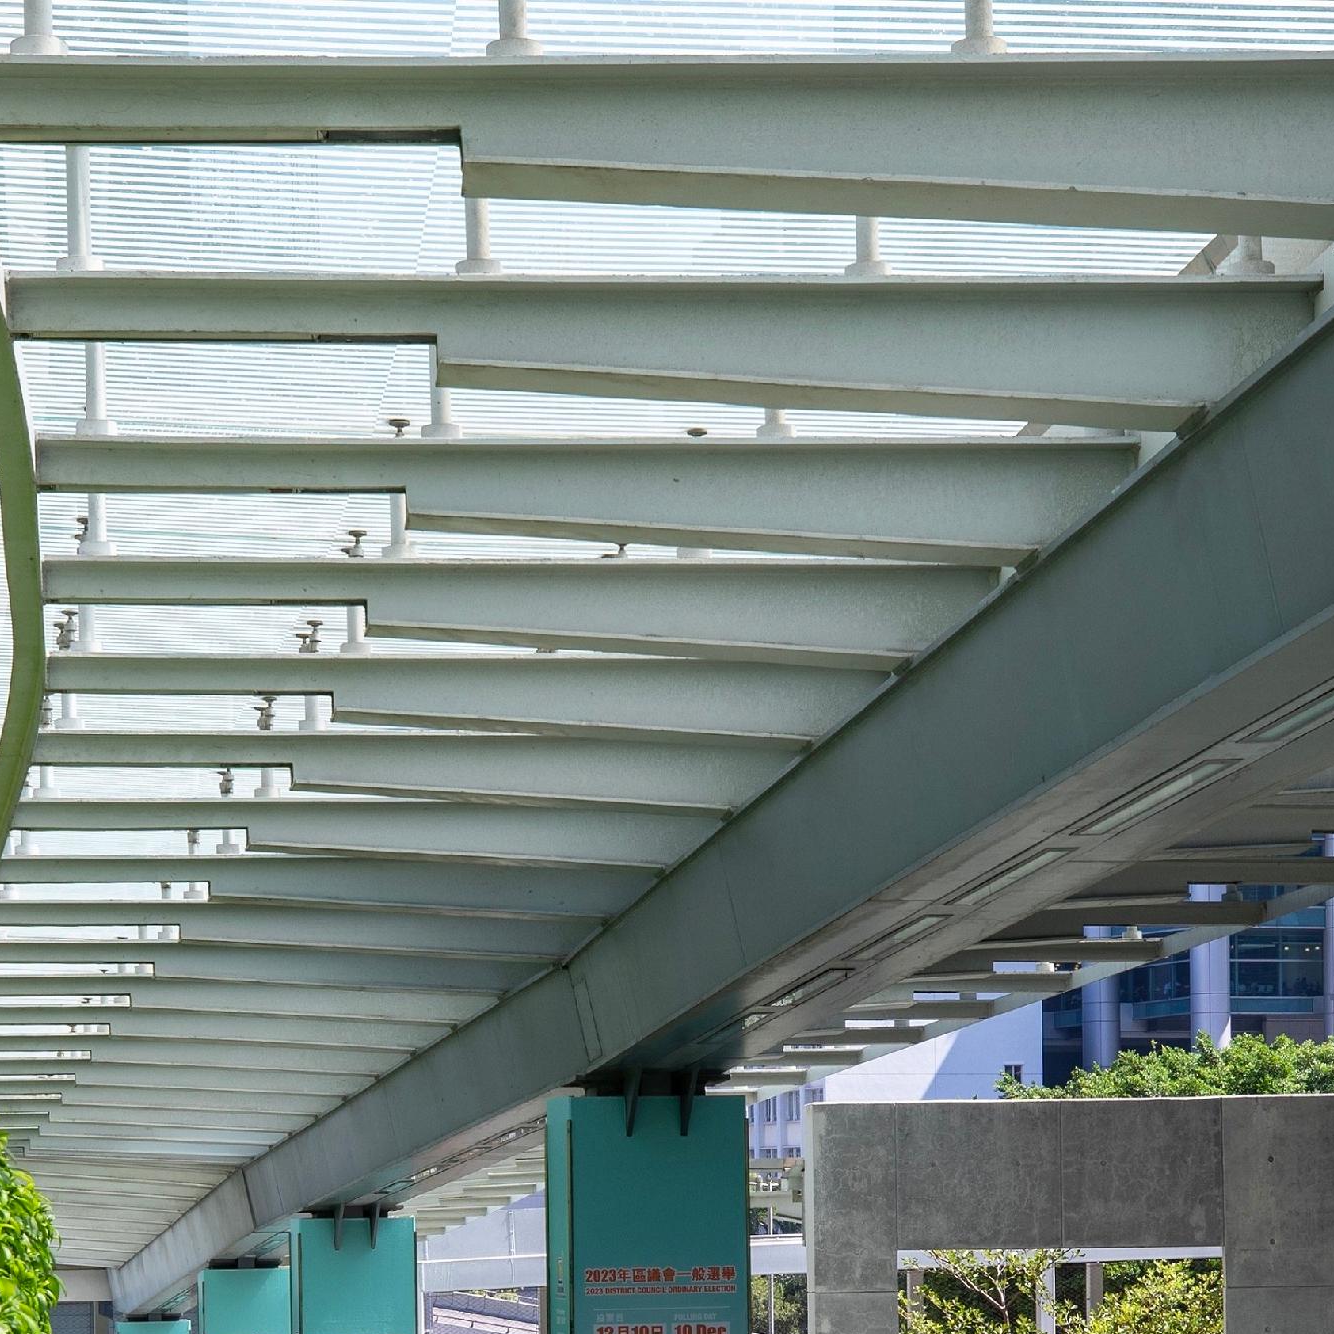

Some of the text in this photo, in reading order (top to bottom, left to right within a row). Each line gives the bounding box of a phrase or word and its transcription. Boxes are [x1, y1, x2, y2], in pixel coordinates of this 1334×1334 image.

[585, 1267, 736, 1283] 2023年區議會一般選舉
[605, 1286, 636, 1295] DISTRICT
[668, 1285, 702, 1294] ORDINARY
[704, 1285, 736, 1293] ELECTION
